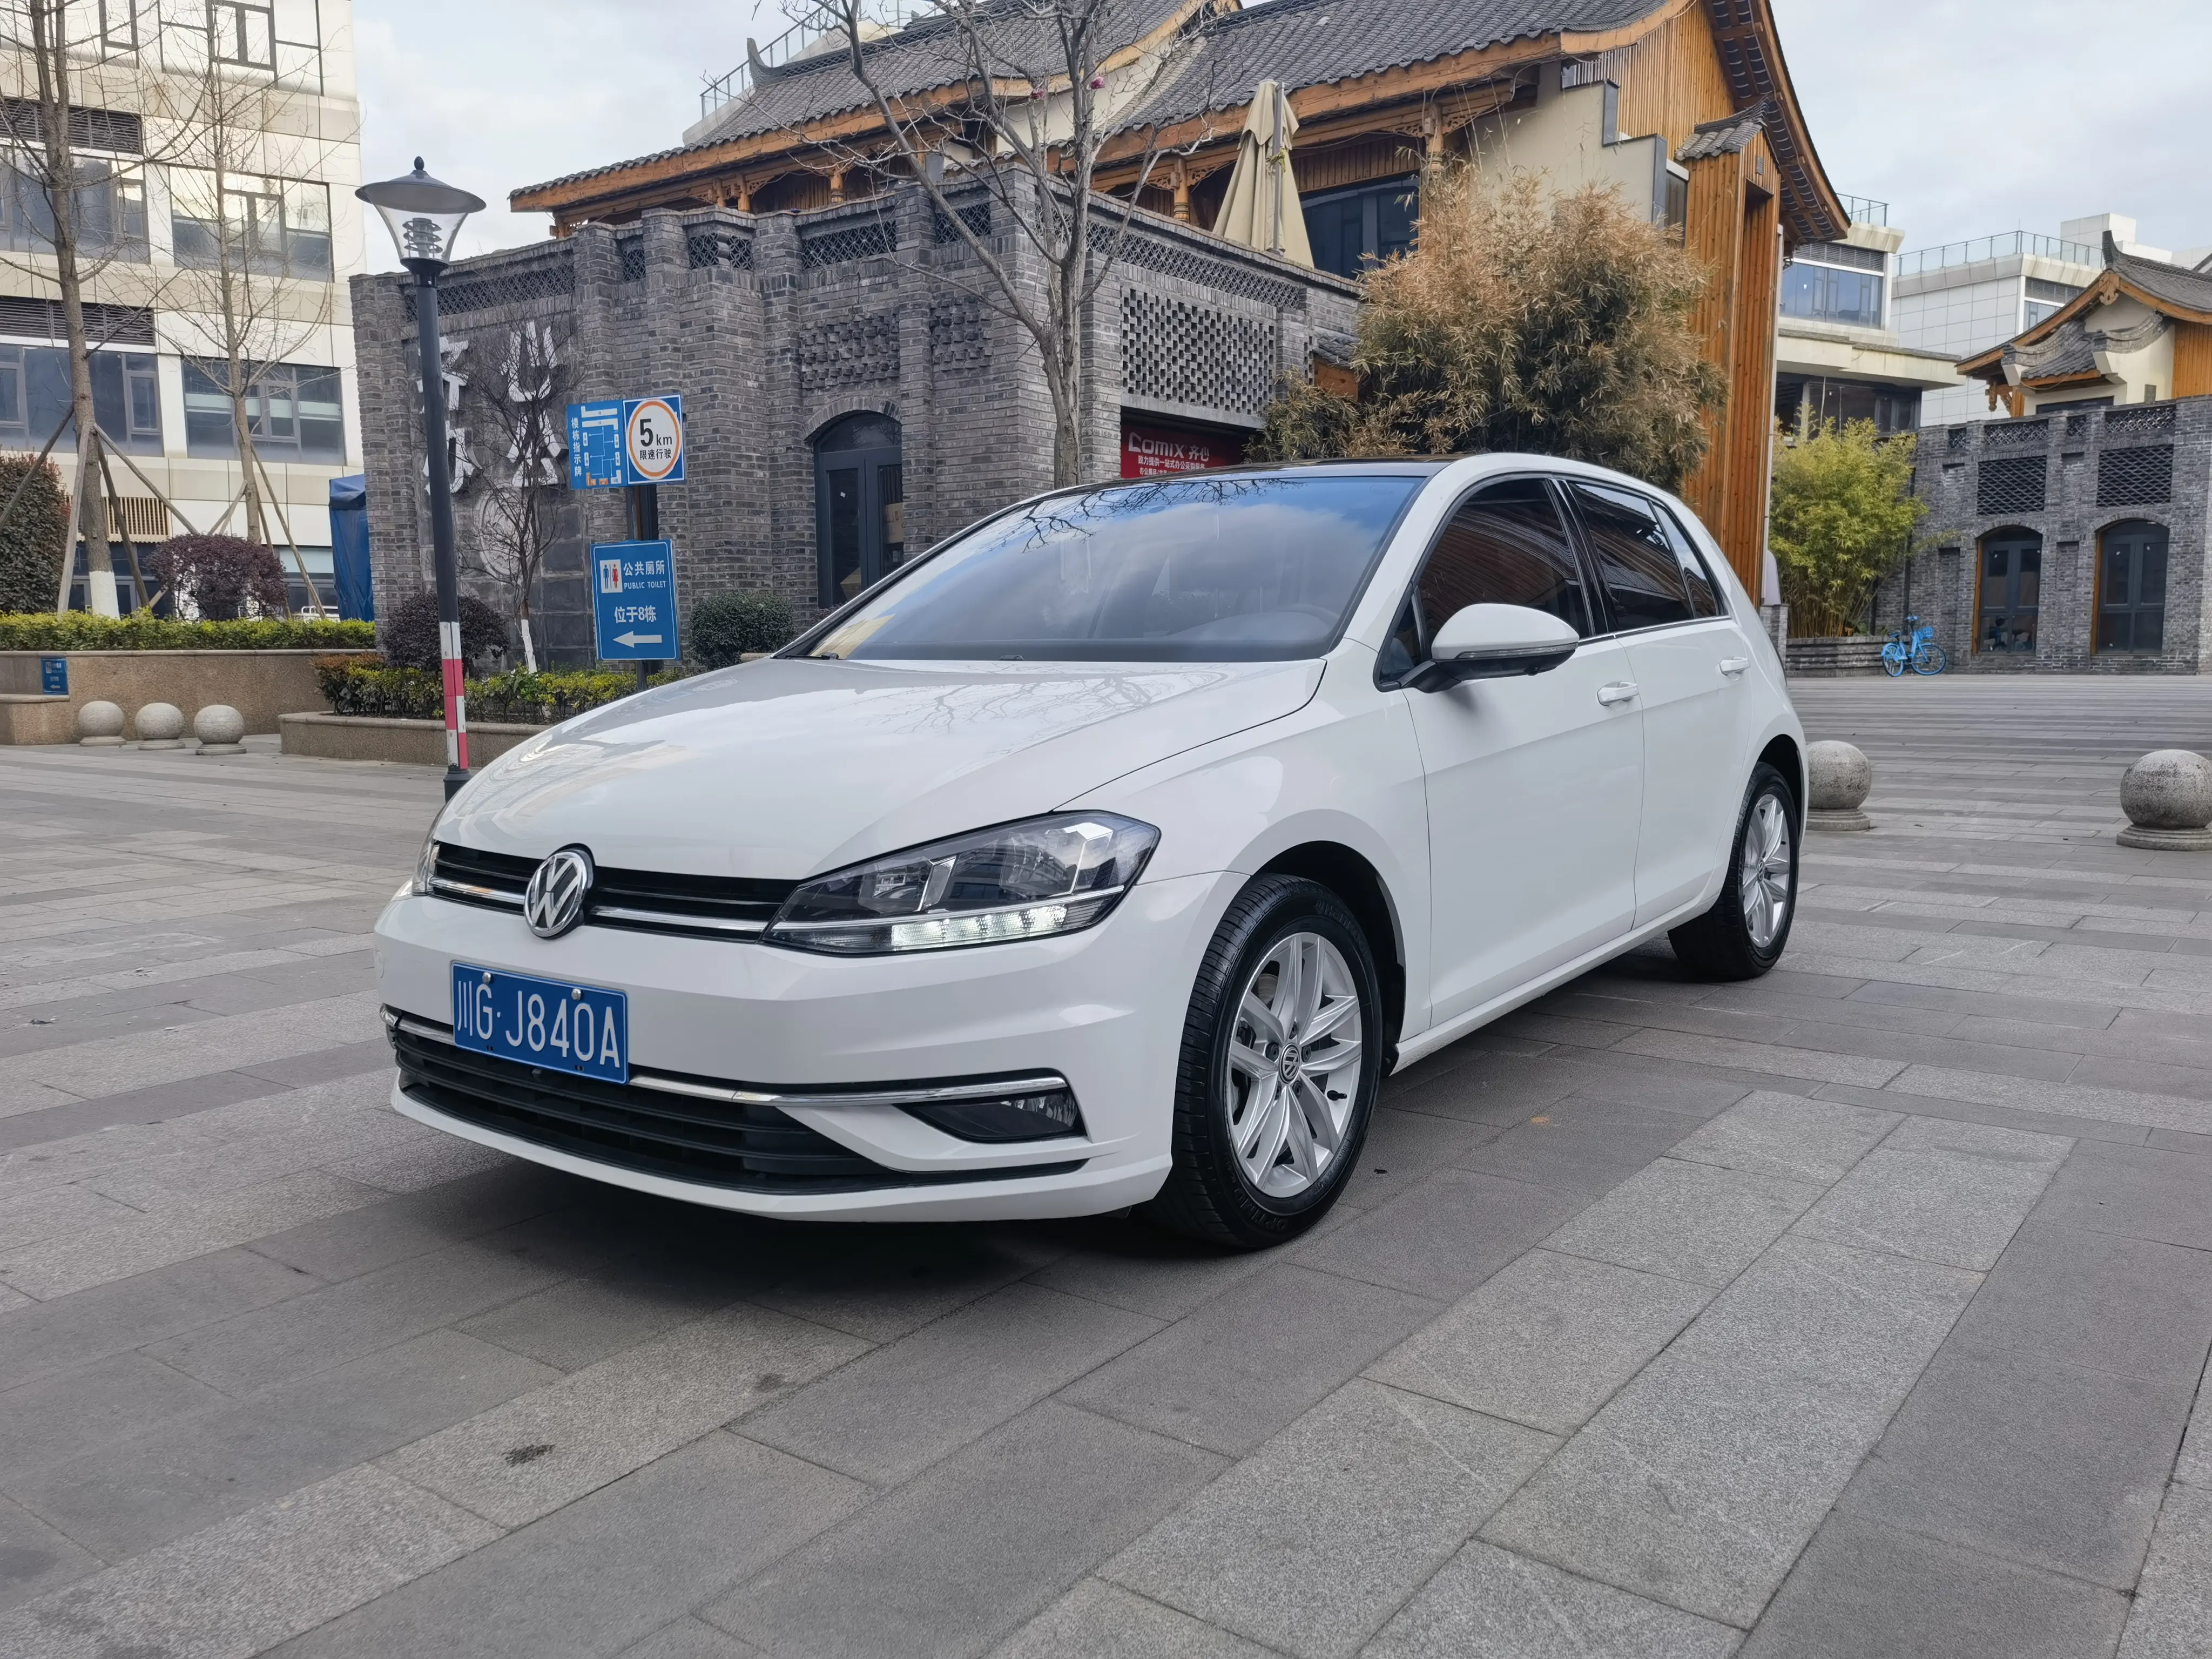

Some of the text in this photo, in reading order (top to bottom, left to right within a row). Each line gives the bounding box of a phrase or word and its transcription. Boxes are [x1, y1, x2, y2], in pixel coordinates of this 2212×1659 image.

[639, 419, 653, 447] 5
[656, 434, 672, 446] km
[571, 417, 582, 477] 楼栋指示牌
[639, 448, 672, 461] 限速行驶
[1188, 444, 1210, 462] 齐心
[623, 560, 665, 576] 公共厕所
[647, 581, 666, 589] TOILET
[614, 605, 657, 624] 位于8栋
